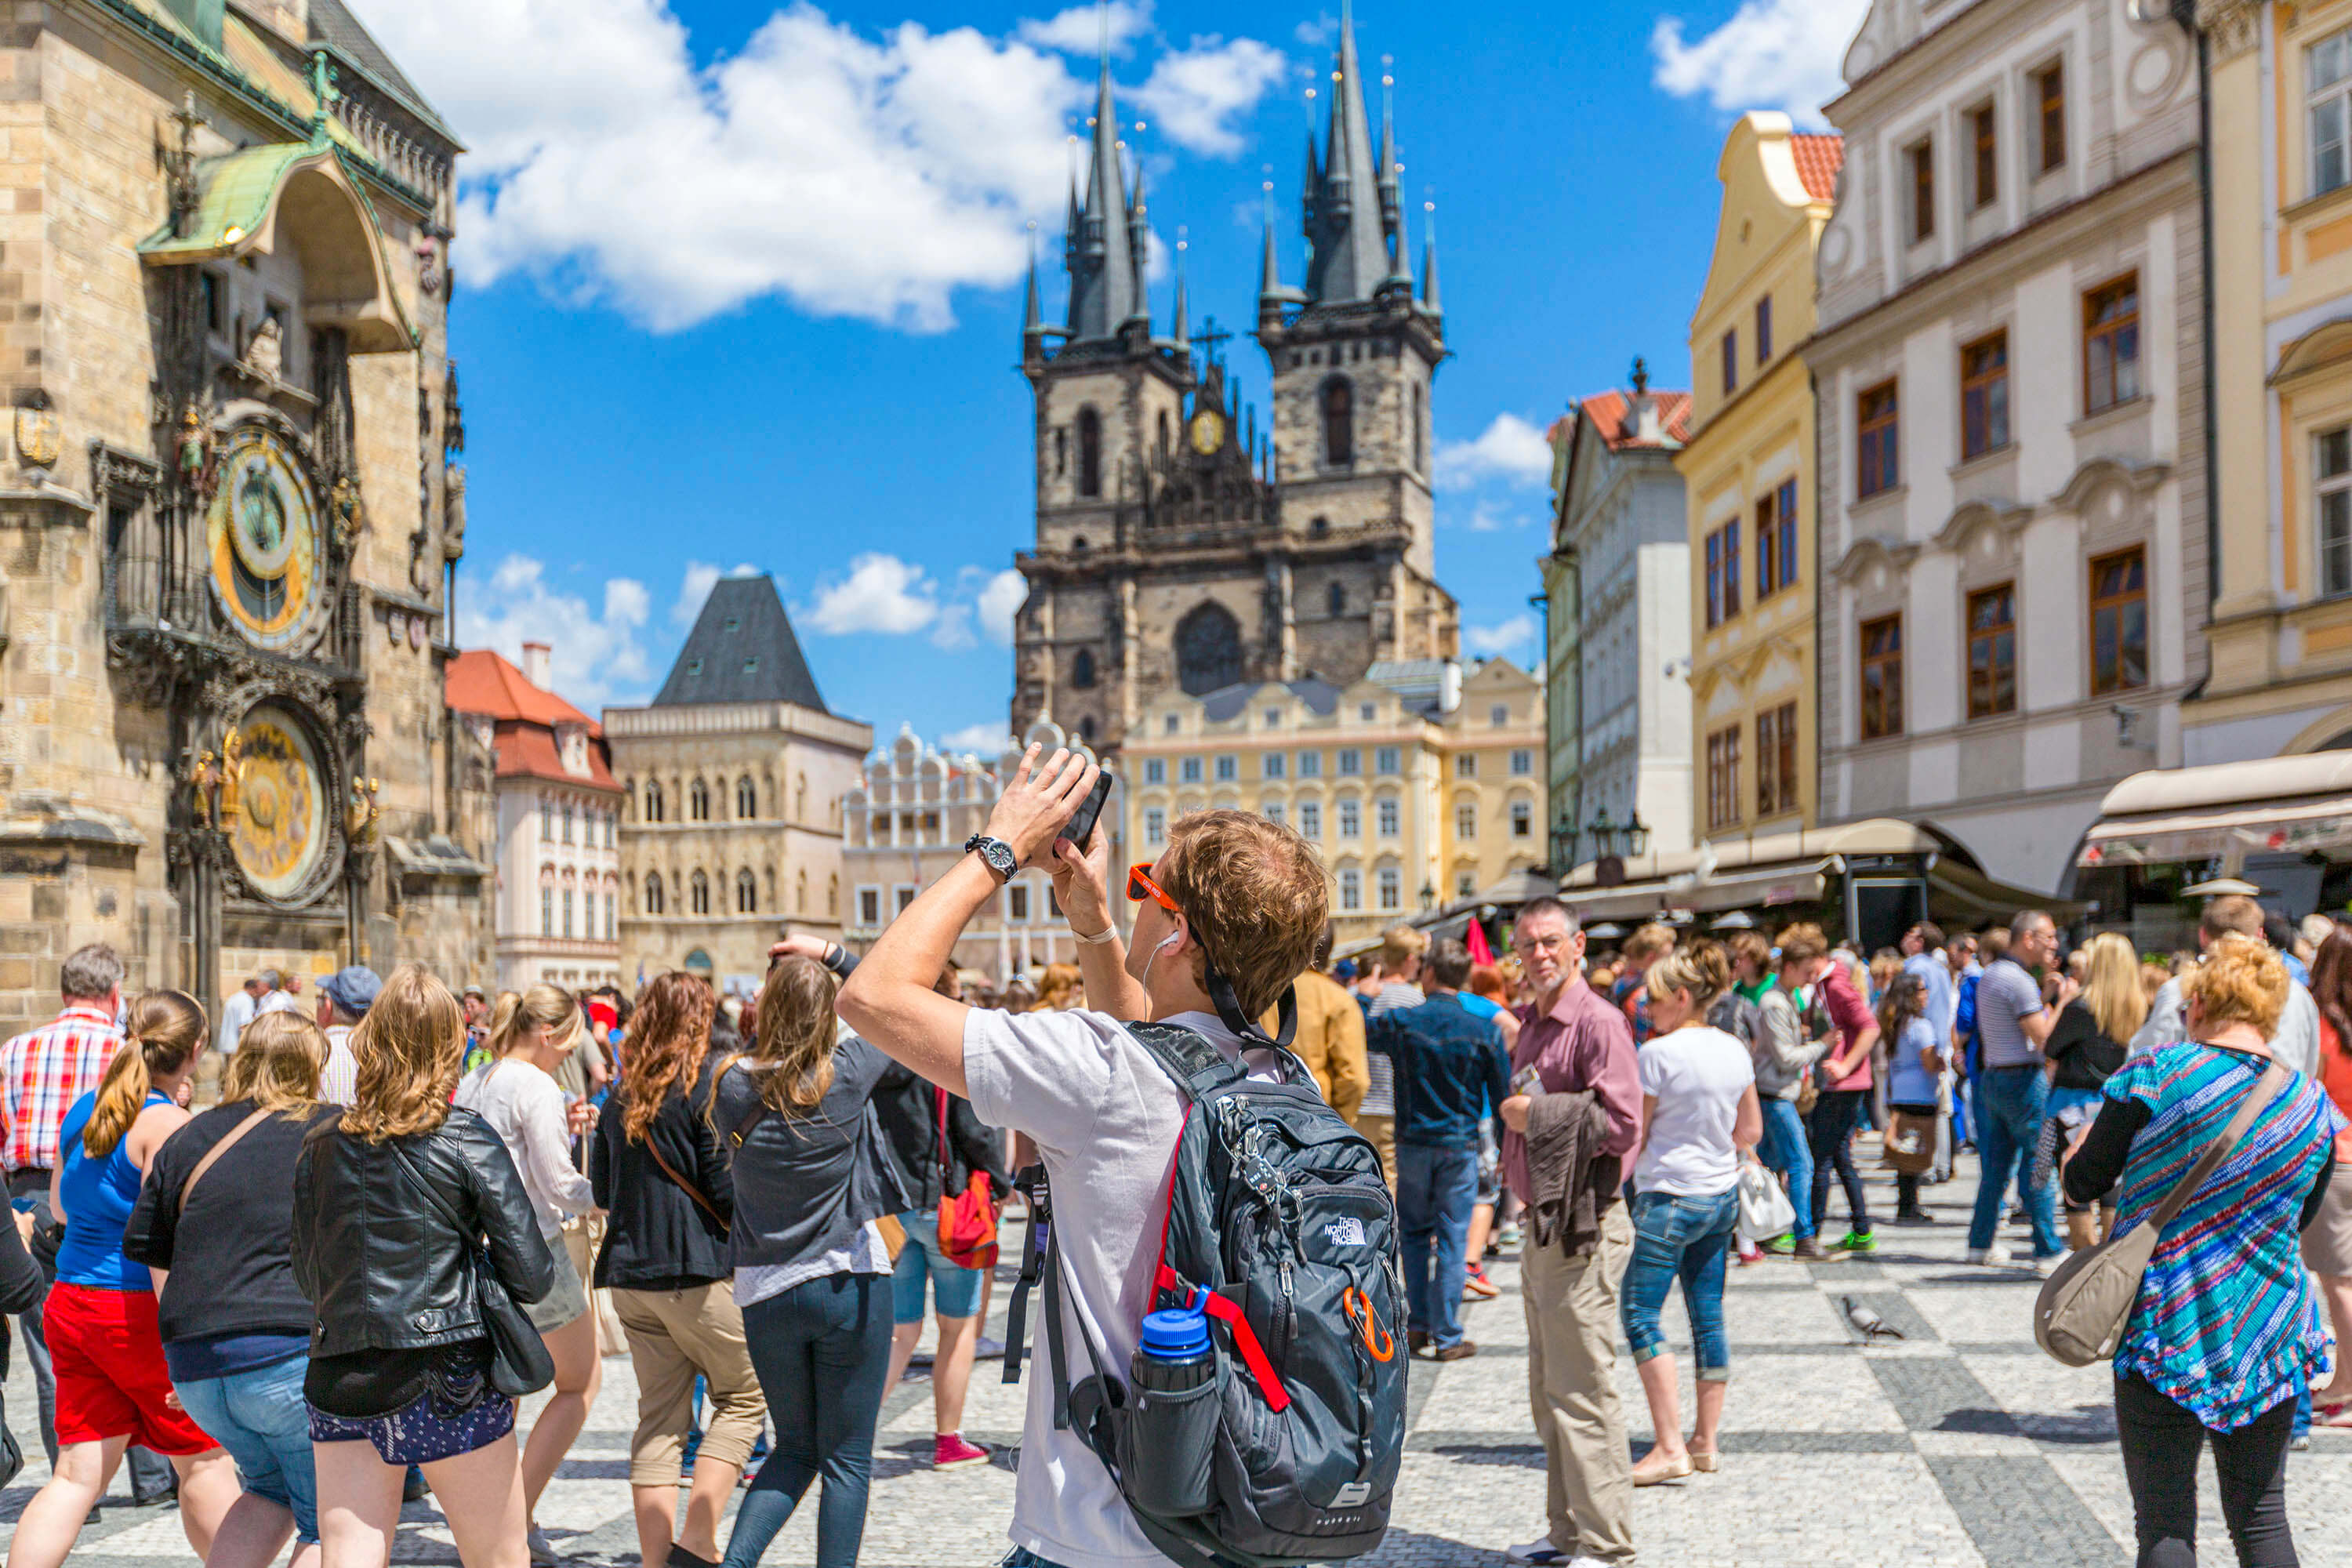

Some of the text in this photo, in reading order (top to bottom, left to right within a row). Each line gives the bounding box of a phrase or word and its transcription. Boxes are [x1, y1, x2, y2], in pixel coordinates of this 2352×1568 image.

[1151, 887, 1161, 898] MED
[1339, 1217, 1354, 1228] THE
[1325, 1225, 1352, 1236] NORTH
[1332, 1236, 1353, 1246] FACE
